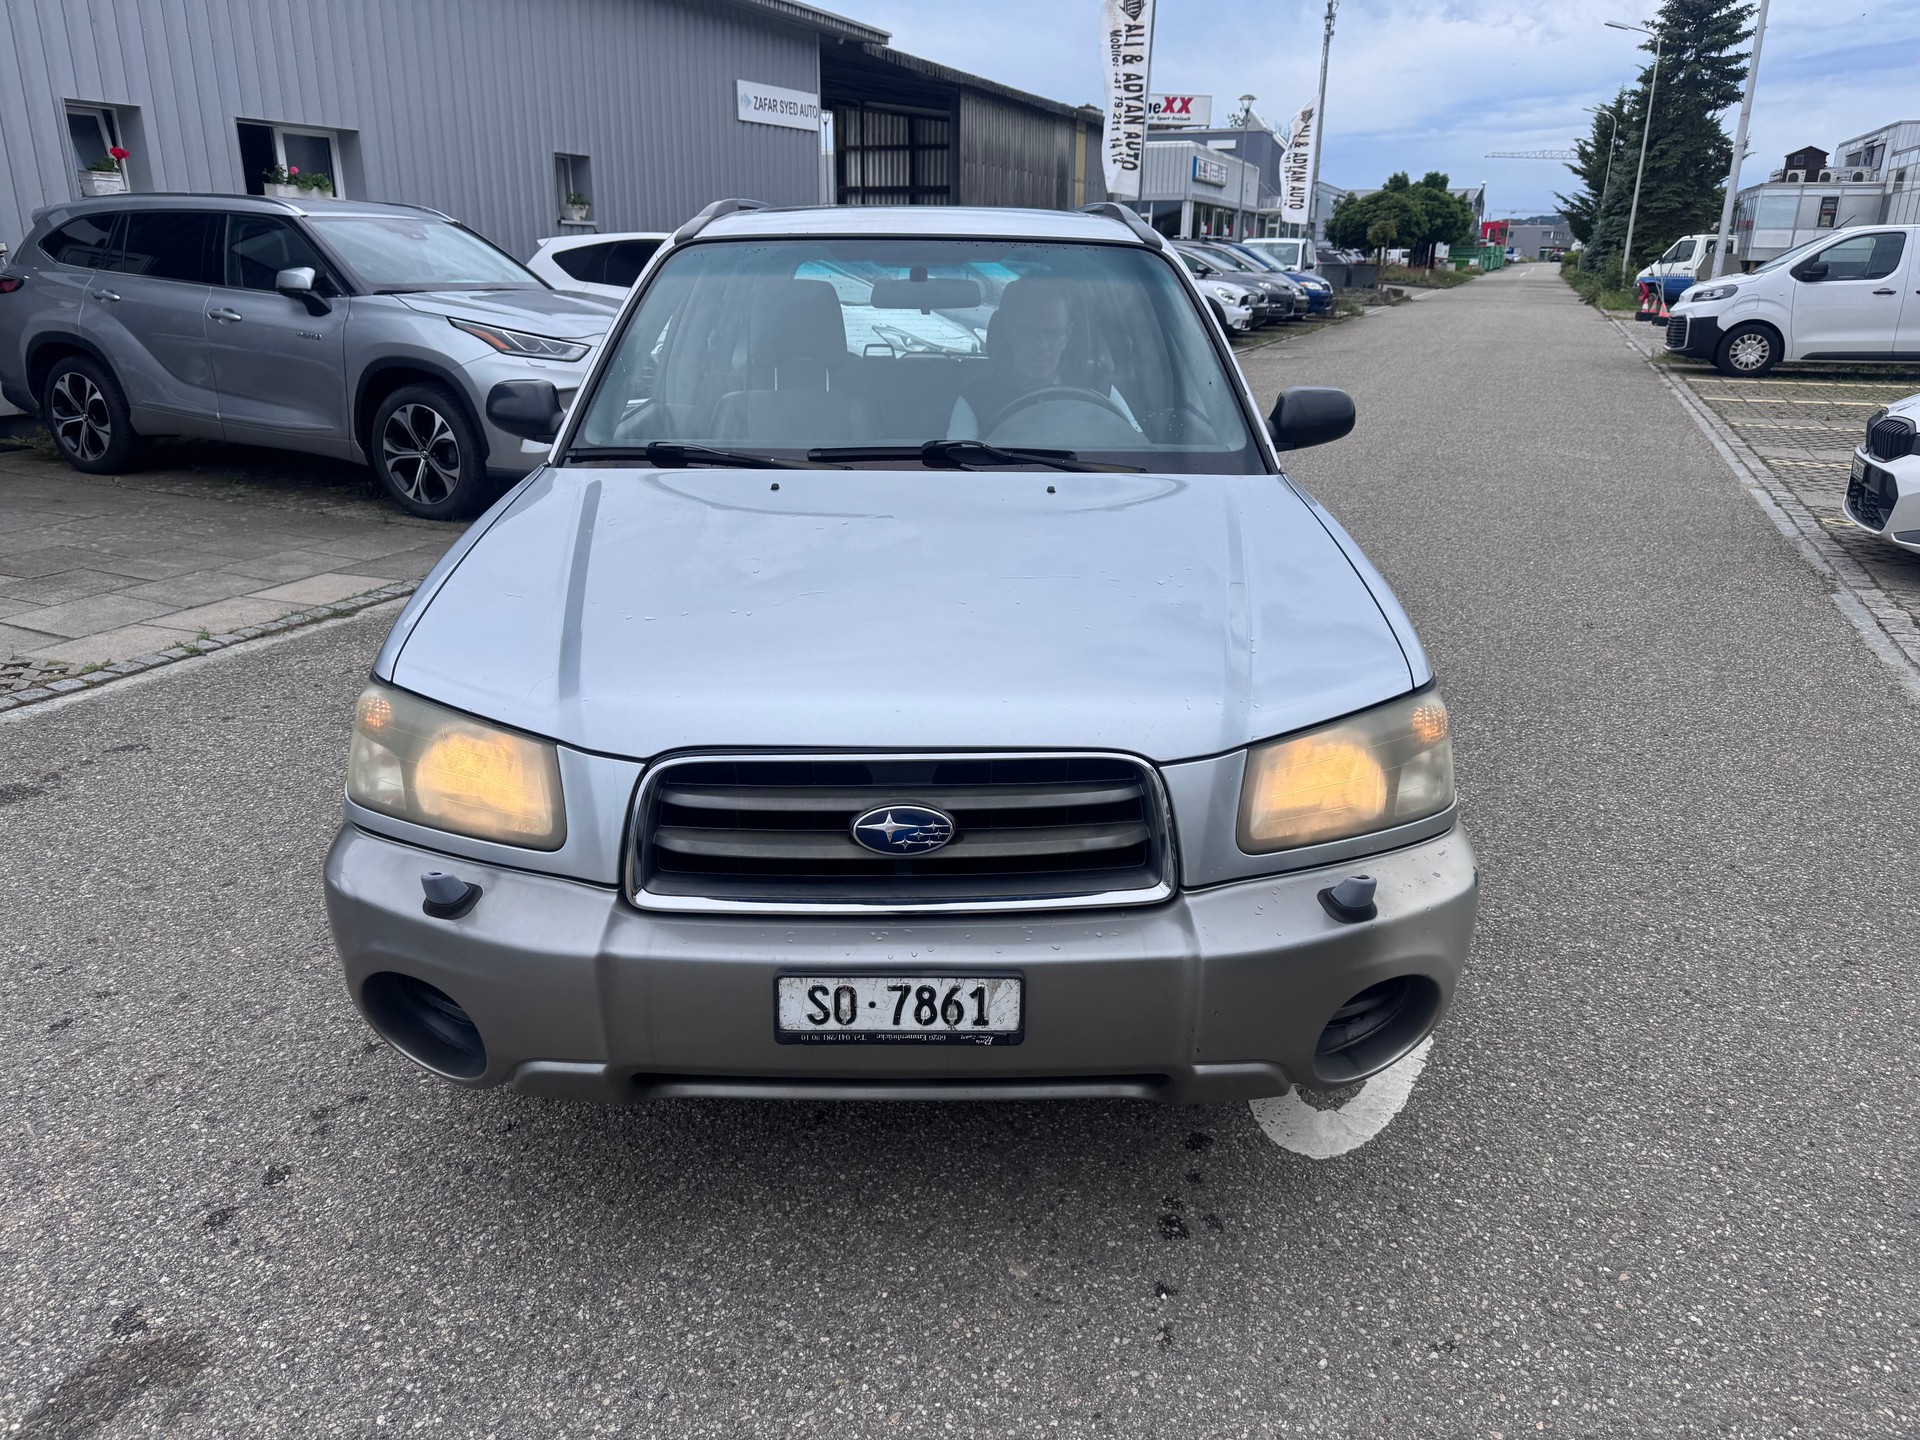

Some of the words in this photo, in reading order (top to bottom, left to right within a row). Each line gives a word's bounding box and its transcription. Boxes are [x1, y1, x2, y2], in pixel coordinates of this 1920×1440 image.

[1124, 24, 1144, 46] ALI
[1122, 54, 1144, 65] &
[753, 96, 778, 113] ZAFAR
[780, 100, 798, 116] SYED
[800, 104, 818, 119] AUTO
[1114, 96, 1123, 108] 79
[1123, 73, 1144, 124] ADYAN
[1111, 113, 1121, 131] 211
[1110, 137, 1123, 149] 14
[1122, 131, 1141, 170] AUTO
[1291, 152, 1308, 182] ADYAN
[1289, 186, 1305, 210] AUTO
[807, 984, 857, 1026] SO
[887, 983, 989, 1026] 7861
